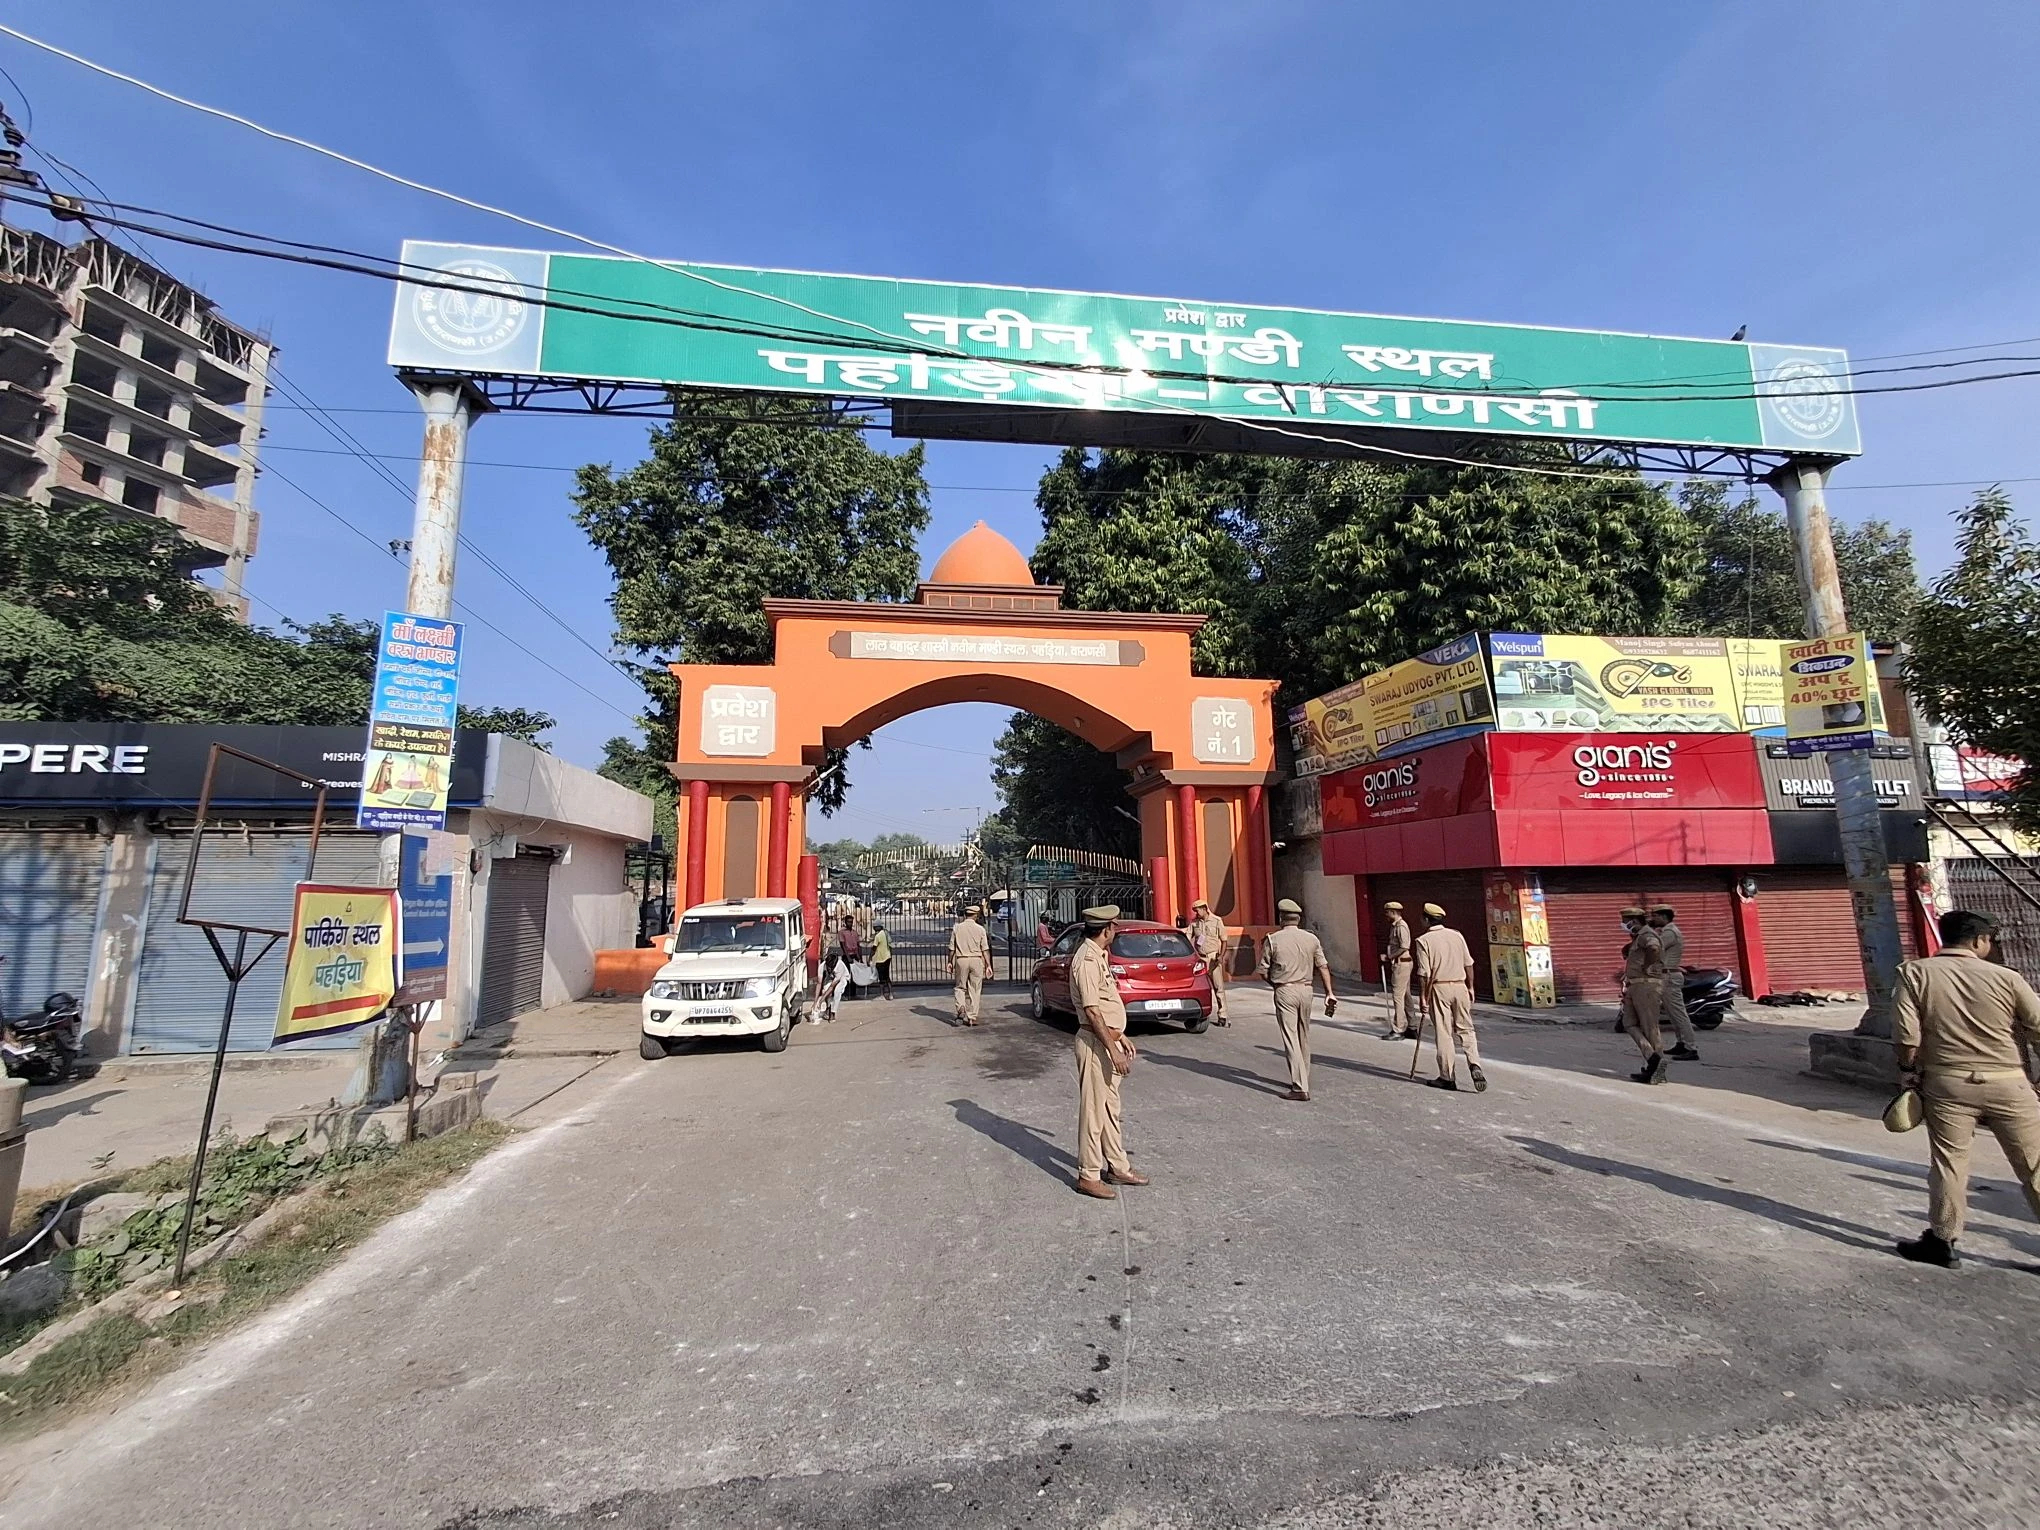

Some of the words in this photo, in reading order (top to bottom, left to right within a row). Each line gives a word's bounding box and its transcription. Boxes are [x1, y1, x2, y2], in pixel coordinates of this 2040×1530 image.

[1163, 298, 1206, 326] प्रवेश
[1214, 312, 1247, 329] द्वार
[903, 308, 1093, 354] नवीन
[1130, 326, 1303, 369] मण्डी
[1341, 343, 1495, 380] स्थल
[1243, 382, 1599, 430] वाराणसी
[391, 617, 416, 641] माँ
[414, 624, 456, 648] लक्ष्मी
[387, 641, 415, 660] वस्त्र
[416, 646, 457, 665] भण्डार
[865, 639, 888, 652] लाल
[920, 637, 949, 653] शास्त्री
[949, 639, 977, 654] नवीन
[978, 640, 1002, 655] मण्डी
[1069, 643, 1106, 658] वाराणसी
[1492, 640, 1541, 656] Welspun
[1615, 639, 1641, 648] Manoj
[1643, 640, 1666, 648] Singh
[1787, 639, 1830, 660] खादी
[1833, 637, 1856, 651] पर
[1433, 645, 1471, 664] VEKA
[1369, 691, 1401, 707] SWARAJ
[1404, 676, 1434, 696] UDYOG
[1435, 671, 1456, 685] PVT.
[1457, 661, 1480, 678] LTD.
[1659, 687, 1689, 695] GLOBAL
[1690, 687, 1713, 695] INDIA
[1798, 673, 1832, 688] अप
[710, 691, 769, 719] प्रवेश
[1641, 697, 1674, 708] SPC
[1676, 698, 1717, 709] Tiles
[1790, 689, 1828, 704] 40%
[1830, 686, 1862, 702] छूट
[1211, 704, 1237, 729] गेट
[373, 738, 385, 747] के
[717, 724, 760, 746] द्वार
[1232, 735, 1241, 756] 1
[1780, 778, 1835, 796] BRAND
[304, 916, 350, 949] पार्किंग
[352, 923, 383, 946] स्थल
